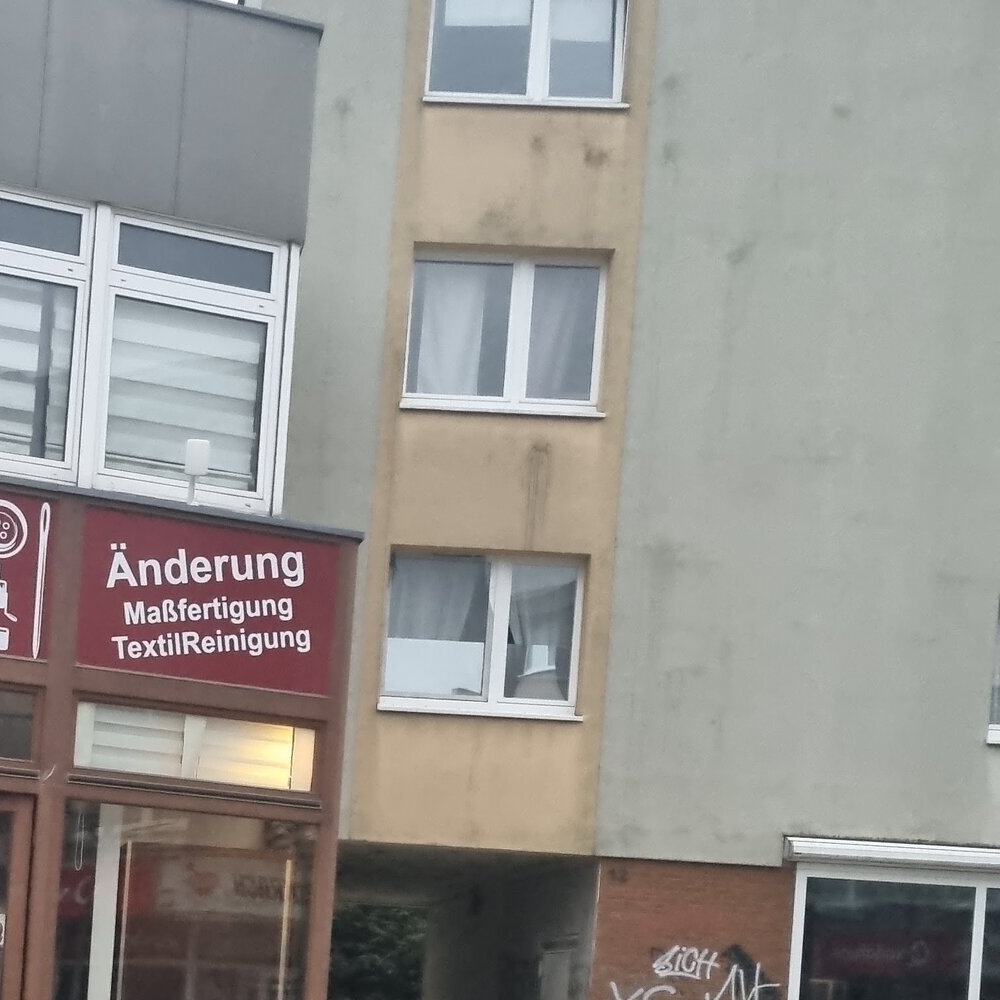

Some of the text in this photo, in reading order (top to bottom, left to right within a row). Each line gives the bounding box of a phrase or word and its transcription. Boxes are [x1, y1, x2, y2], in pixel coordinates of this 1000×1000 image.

[106, 543, 305, 587] Änderung
[123, 596, 293, 625] Maßfertigung
[111, 628, 311, 660] TextilReinigung
